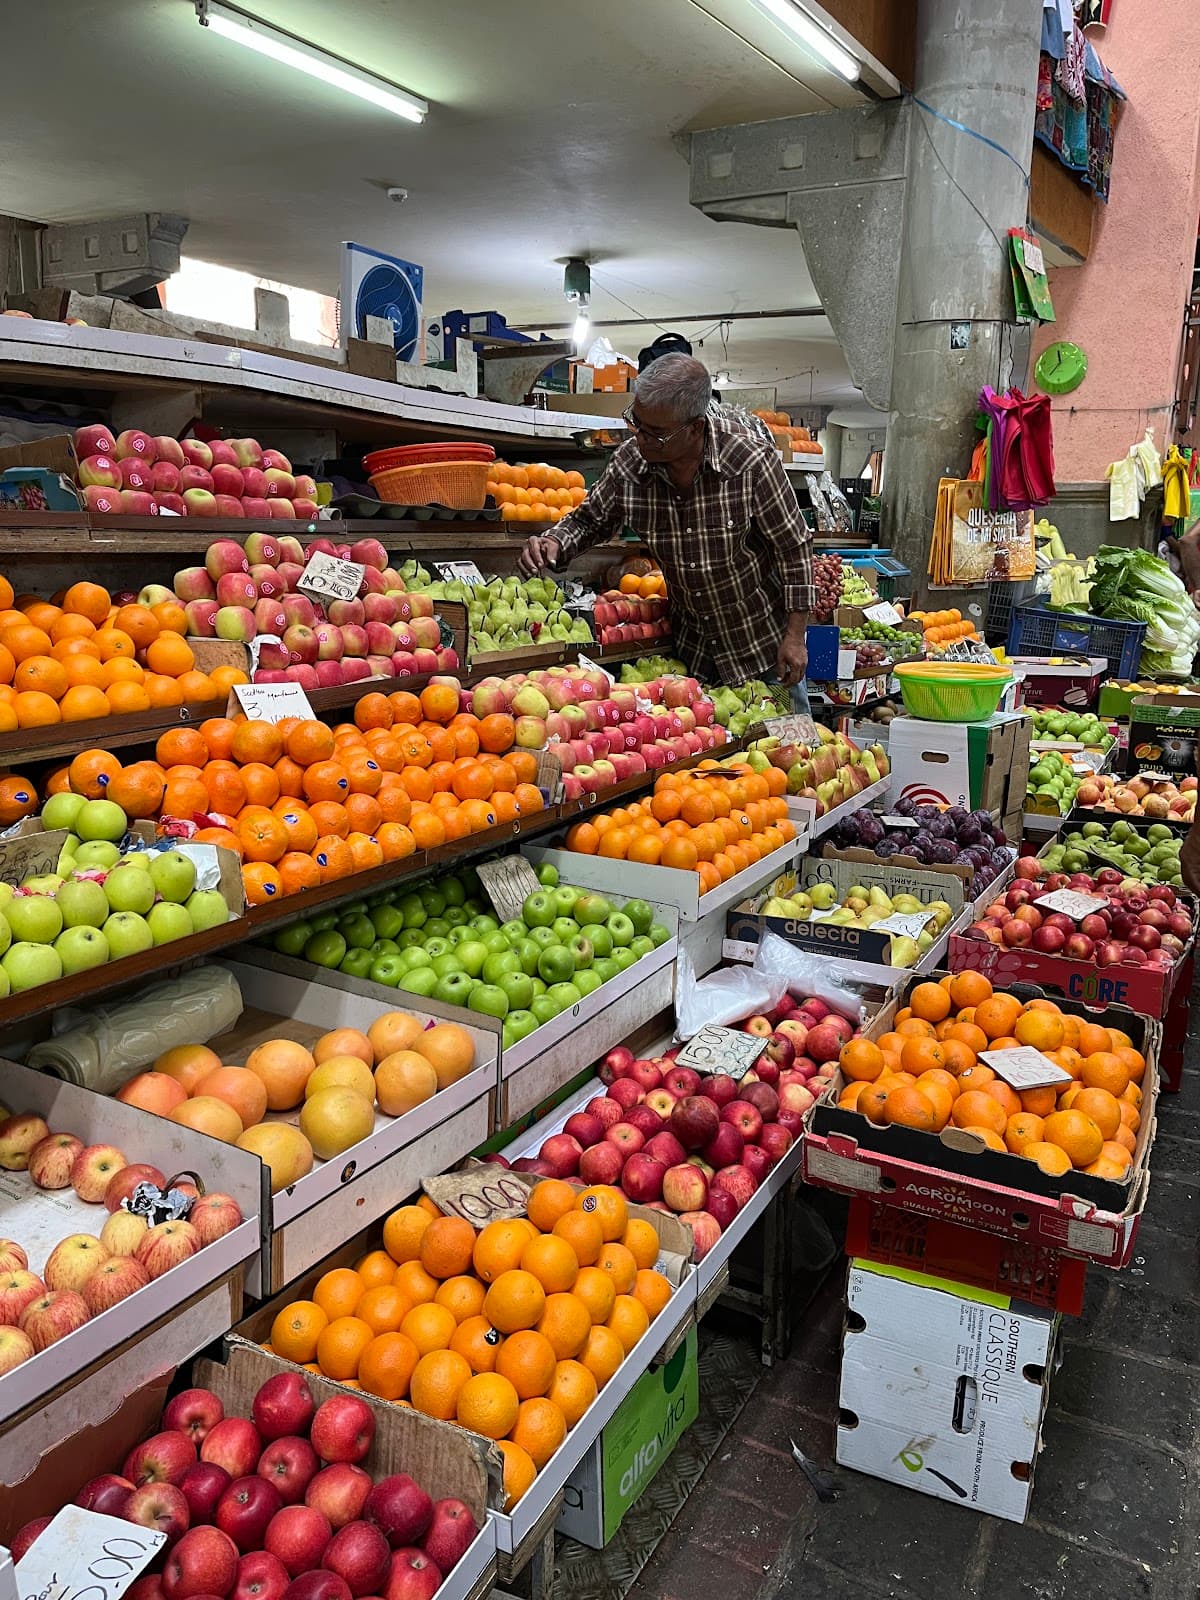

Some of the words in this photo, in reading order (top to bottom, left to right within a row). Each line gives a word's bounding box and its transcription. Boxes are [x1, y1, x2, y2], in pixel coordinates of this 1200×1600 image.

[967, 527, 978, 542] DE
[784, 919, 861, 945] delecta
[902, 1200, 942, 1216] QUALITY
[981, 1313, 1006, 1404] CLASSIQUE
[1005, 1318, 1021, 1374] SOUTHERN
[619, 1391, 686, 1497] alfavita
[978, 1420, 986, 1447] PRODUCE
[975, 1446, 983, 1464] FROM
[971, 1483, 979, 1502] AFRICA
